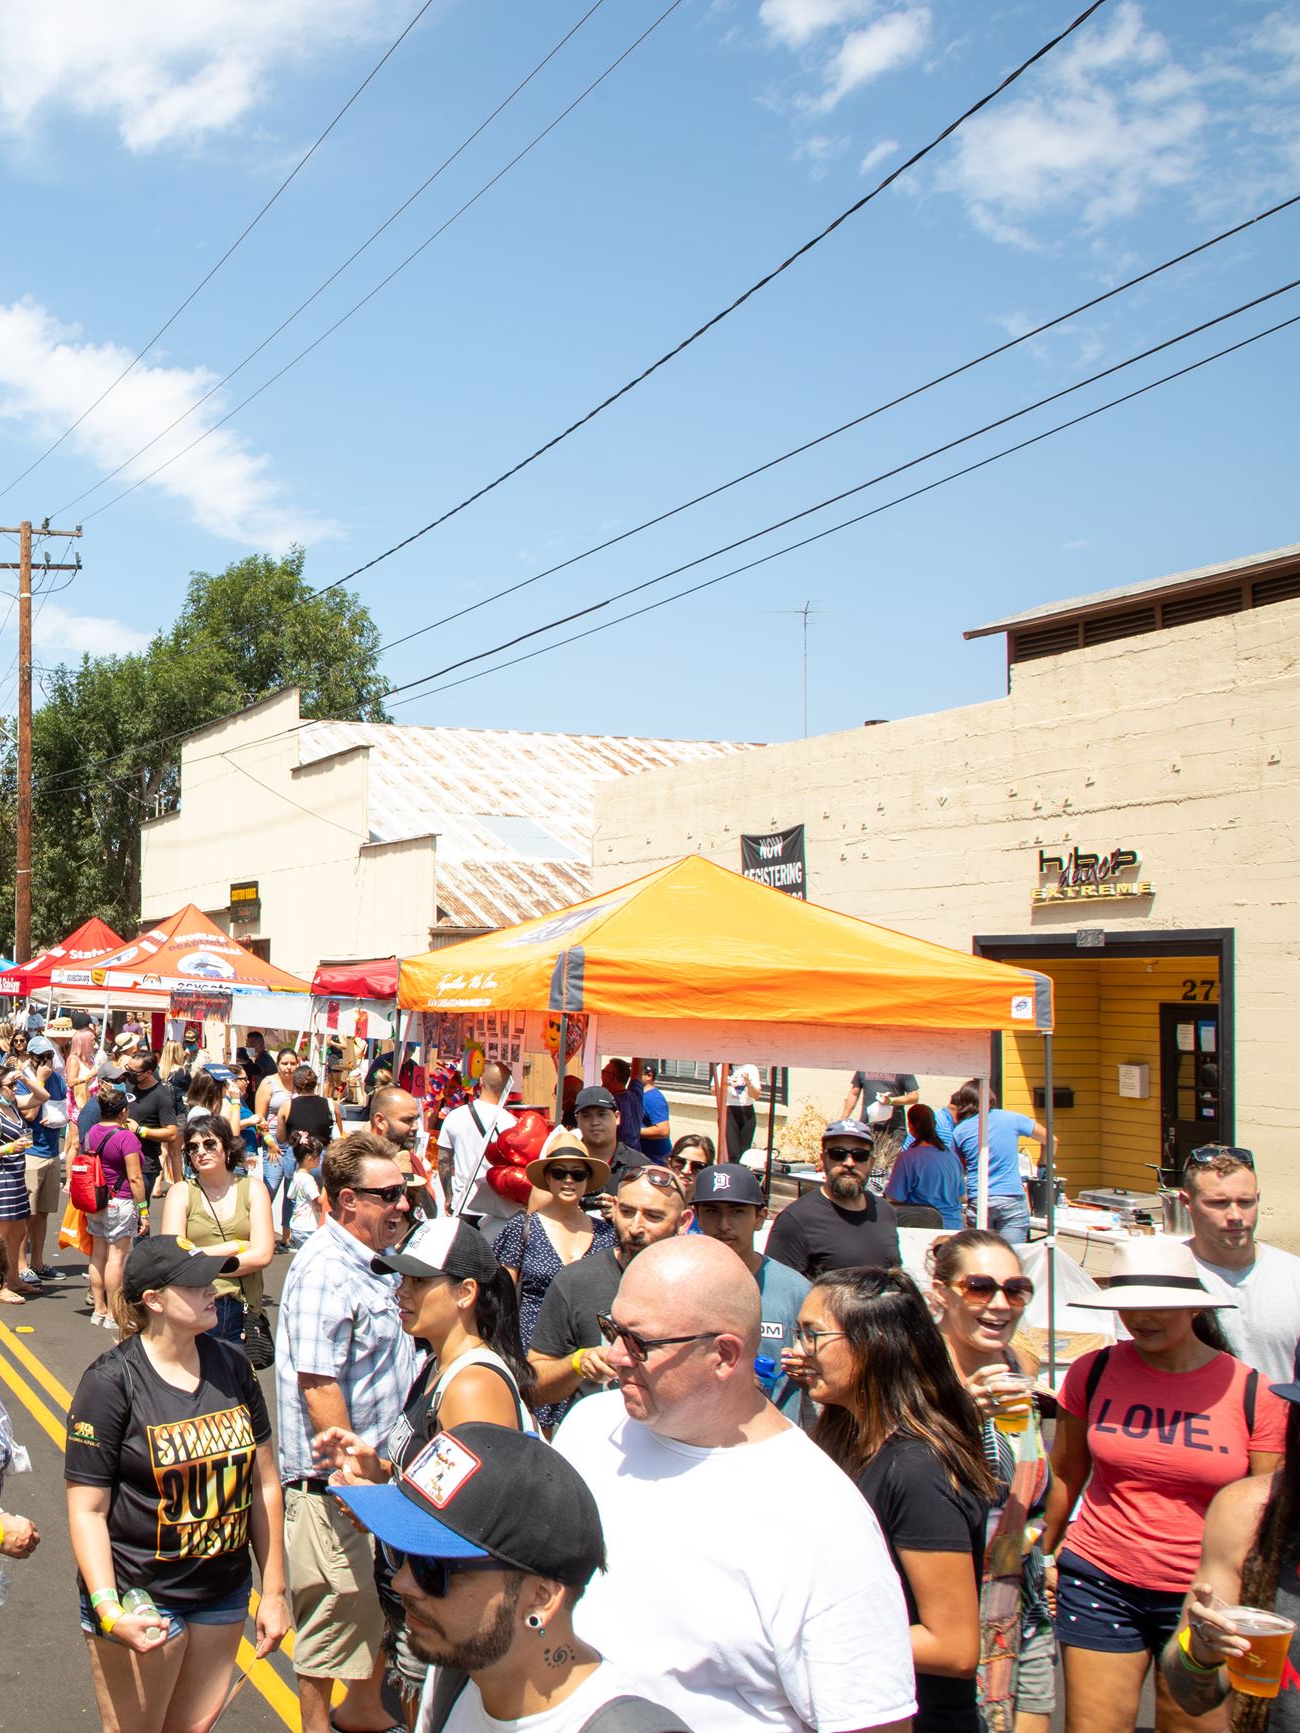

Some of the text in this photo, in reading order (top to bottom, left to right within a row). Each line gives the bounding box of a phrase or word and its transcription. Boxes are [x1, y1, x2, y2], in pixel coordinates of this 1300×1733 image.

[759, 836, 783, 860] NOW
[1030, 881, 1155, 899] EXTREME
[1181, 979, 1219, 1001] 27
[1095, 1398, 1229, 1455] LOVE.
